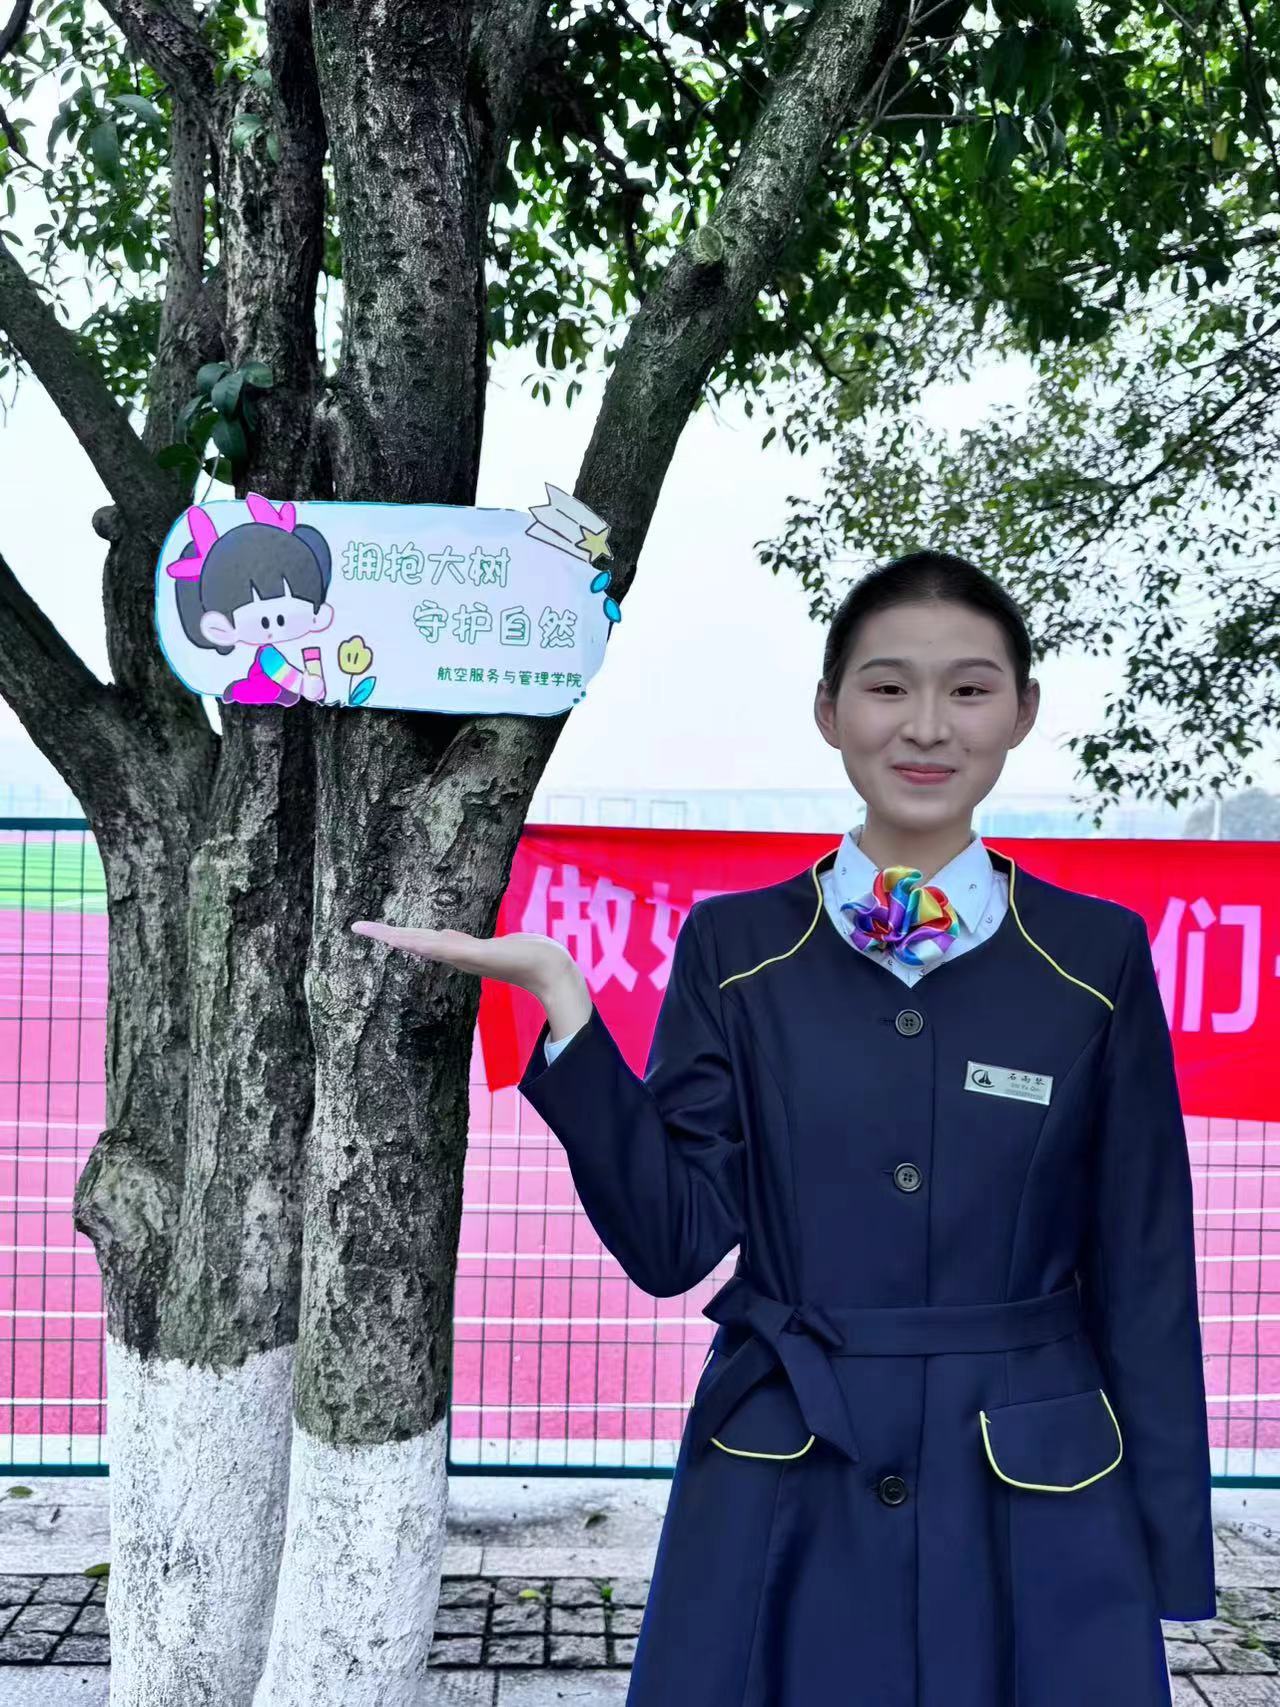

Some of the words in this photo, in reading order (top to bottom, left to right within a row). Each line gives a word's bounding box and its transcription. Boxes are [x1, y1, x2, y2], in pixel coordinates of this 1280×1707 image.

[342, 541, 511, 588] 拥抱大树
[413, 600, 578, 649] 守护自然
[437, 666, 583, 688] 航空服务与管理学院
[1151, 897, 1280, 1033] 们
